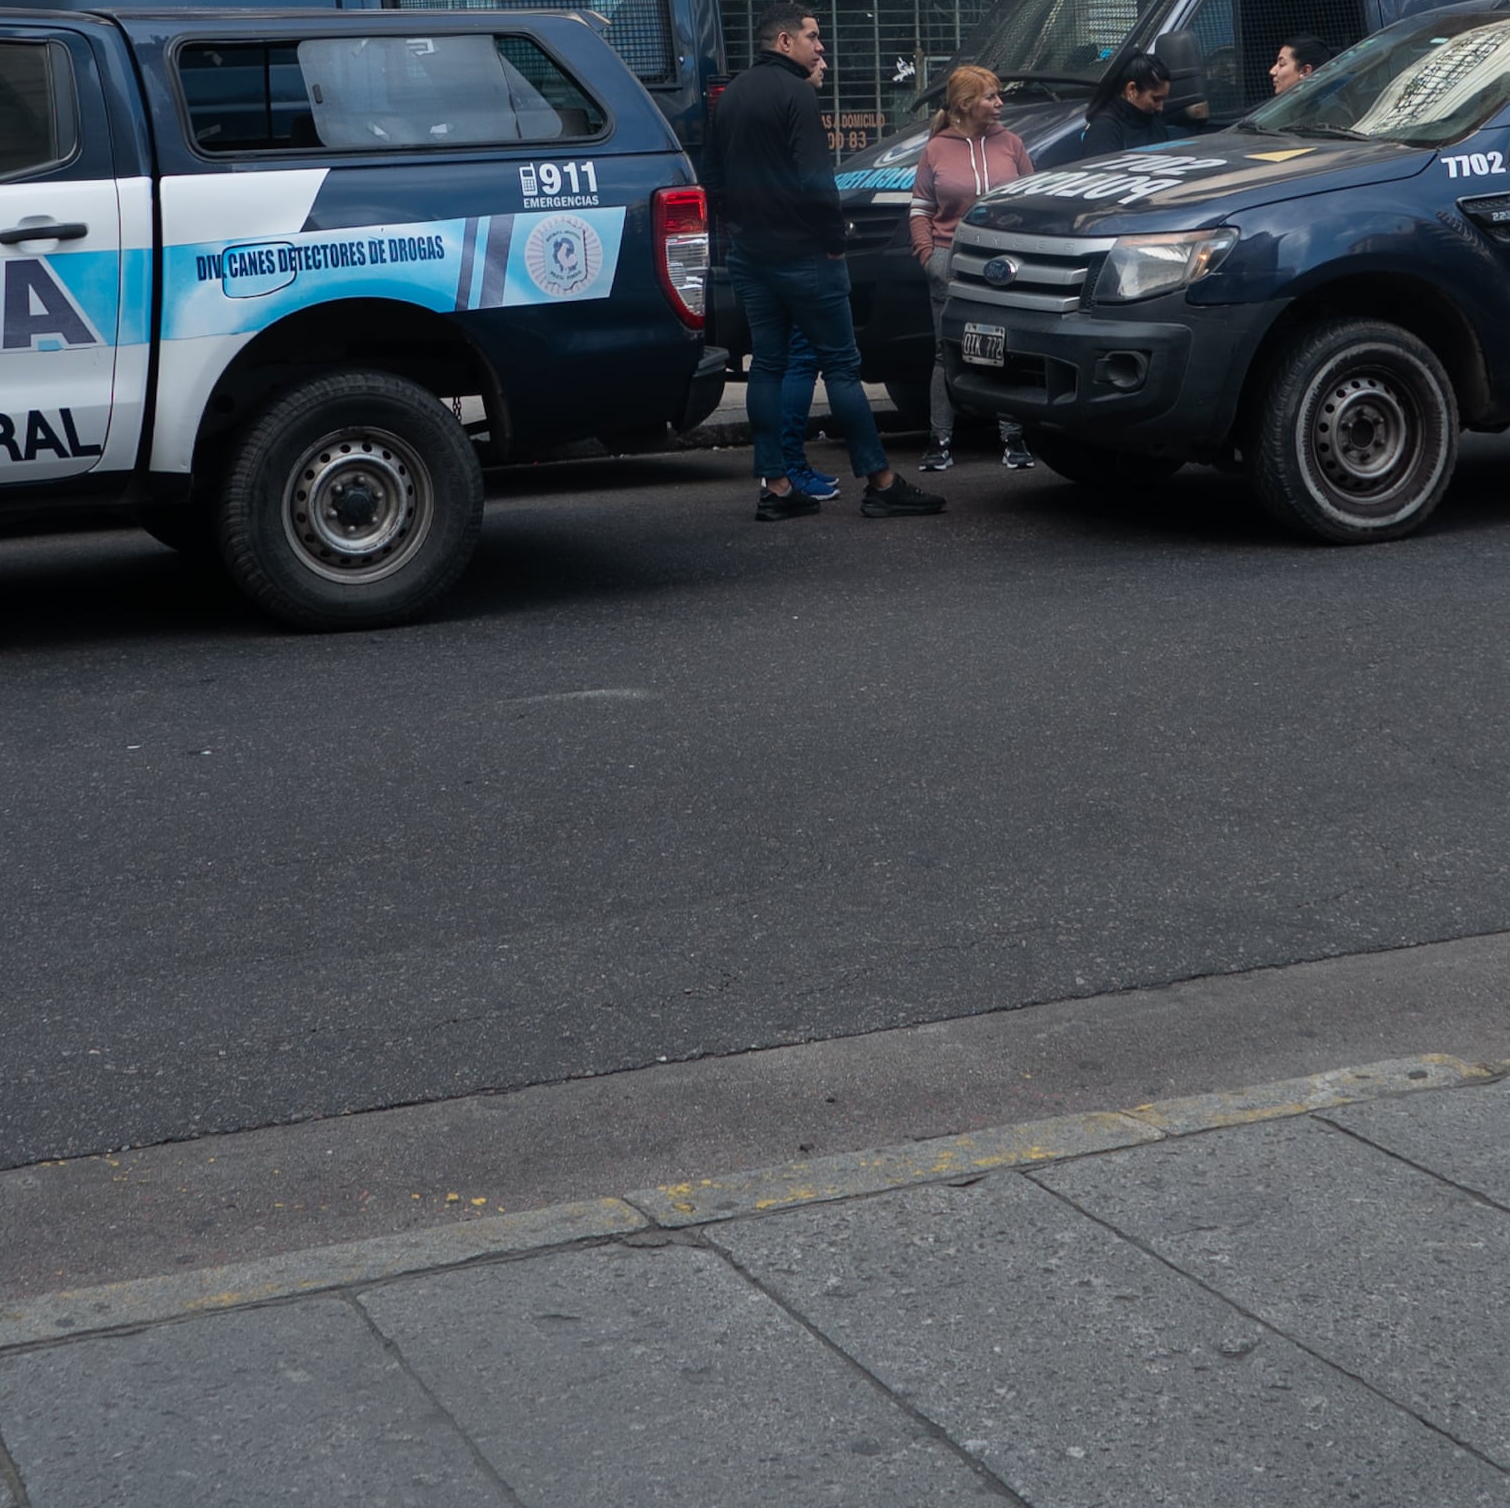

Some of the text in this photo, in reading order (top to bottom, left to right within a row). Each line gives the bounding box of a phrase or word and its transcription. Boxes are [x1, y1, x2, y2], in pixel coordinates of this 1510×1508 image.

[849, 130, 867, 149] 83
[539, 161, 598, 195] 911
[1441, 151, 1506, 179] 7702
[523, 195, 599, 209] EMERGENCIAS
[196, 235, 445, 281] DIV. CANES DETECTORES DE DROGAS
[963, 333, 983, 357] OIK
